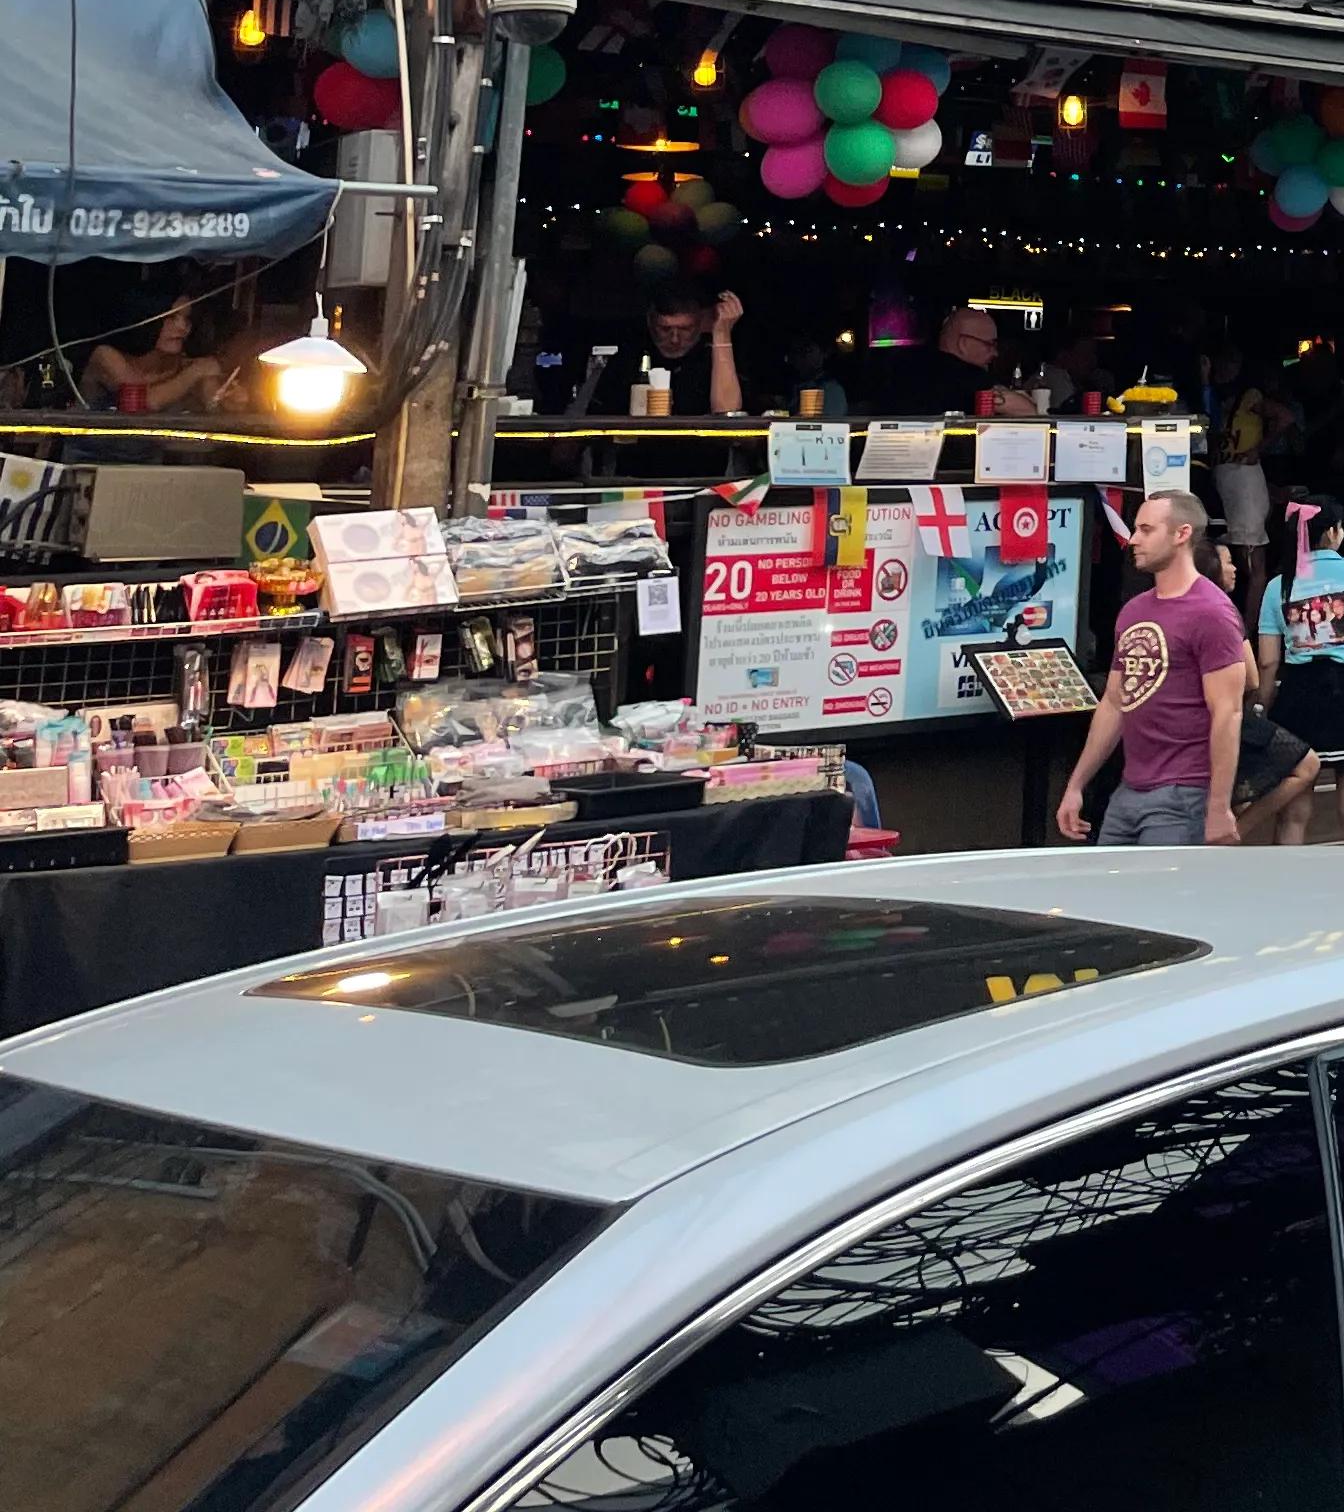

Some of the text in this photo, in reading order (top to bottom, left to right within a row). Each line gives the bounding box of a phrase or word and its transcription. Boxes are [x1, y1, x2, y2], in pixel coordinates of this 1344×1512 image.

[710, 511, 811, 528] NO GAMBLING
[973, 507, 1072, 533] ACPT
[758, 558, 774, 569] NO
[704, 560, 753, 602] 20
[771, 573, 809, 585] BELOW
[836, 570, 862, 580] FOOD
[842, 580, 855, 589] OR
[755, 587, 826, 603] 20 YEARS OLD
[833, 589, 862, 599] DRINK
[951, 651, 971, 669] VI
[704, 703, 723, 715] NO
[726, 703, 738, 714] ID
[751, 700, 769, 711] NO
[773, 696, 810, 710] ENTRY
